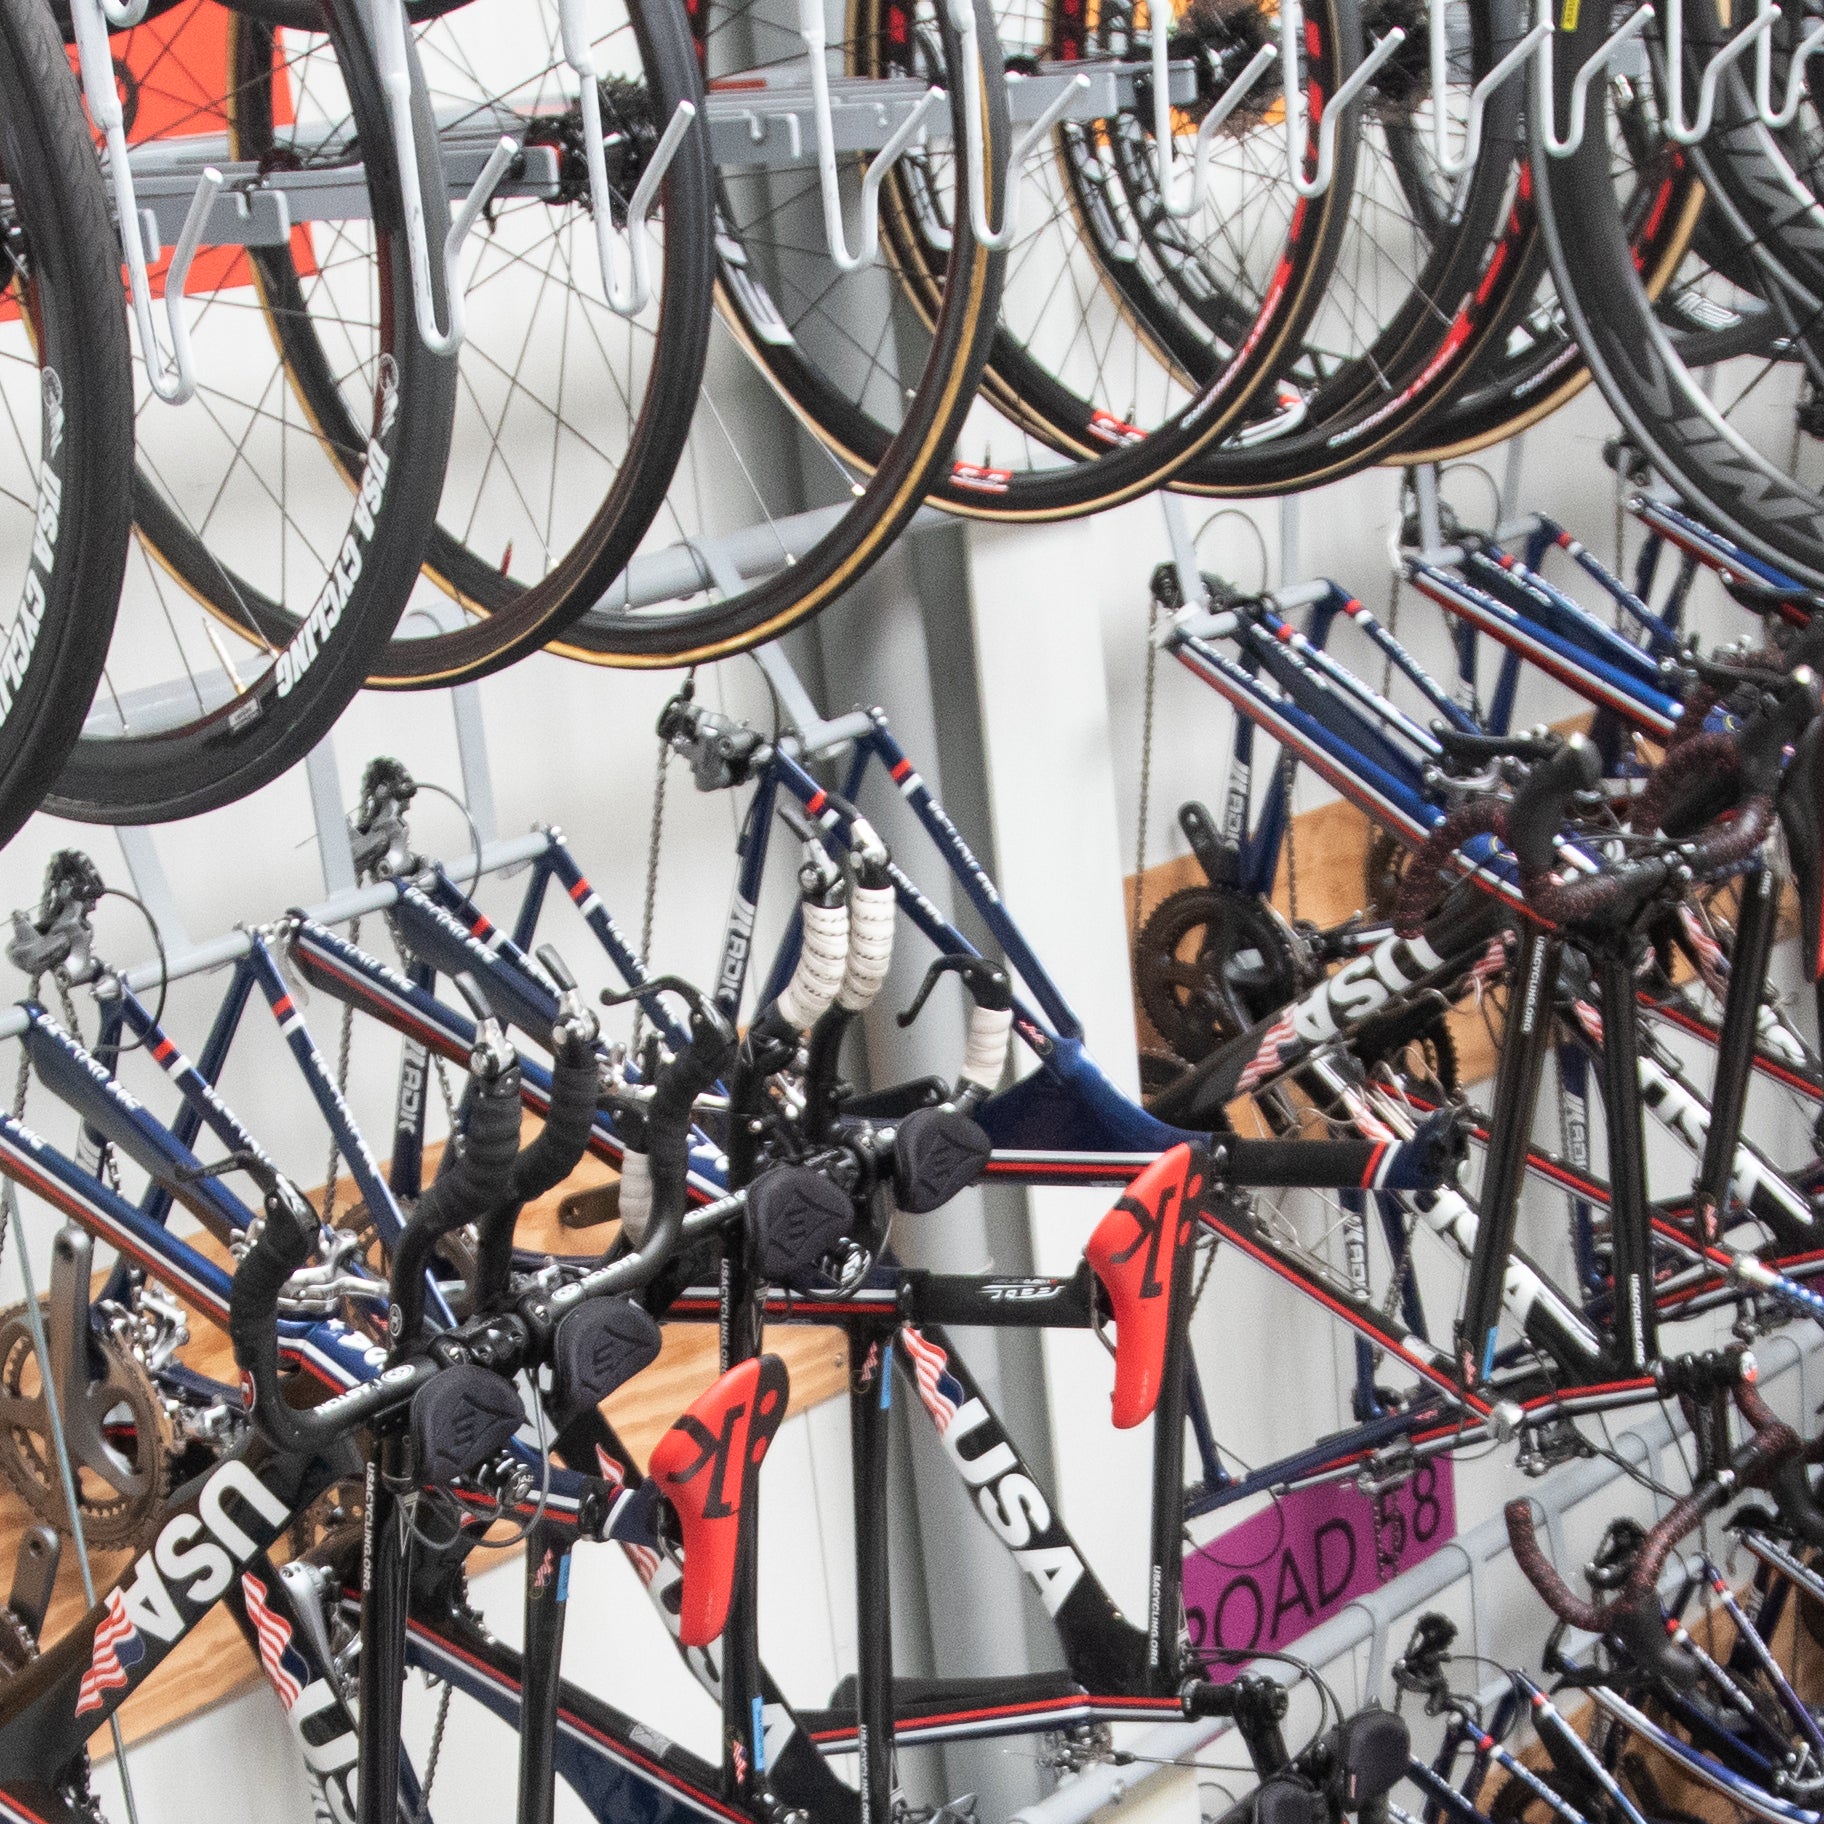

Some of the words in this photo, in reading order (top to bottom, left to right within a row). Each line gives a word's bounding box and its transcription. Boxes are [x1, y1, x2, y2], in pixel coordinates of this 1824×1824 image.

[34, 462, 62, 574] USA
[353, 438, 390, 542] USA
[275, 534, 363, 699] CYCLING
[1297, 936, 1445, 1042] USA
[35, 1012, 110, 1080] CYCLING
[106, 1079, 145, 1111] USA
[4, 1116, 46, 1150] USA
[1629, 1274, 1644, 1367] USACYCLING.ORG
[129, 1458, 293, 1650] USA
[363, 1461, 378, 1594] USACYCLING.ORG
[948, 1396, 1085, 1621] USA
[1150, 1564, 1163, 1667] USACYCLING.ORG
